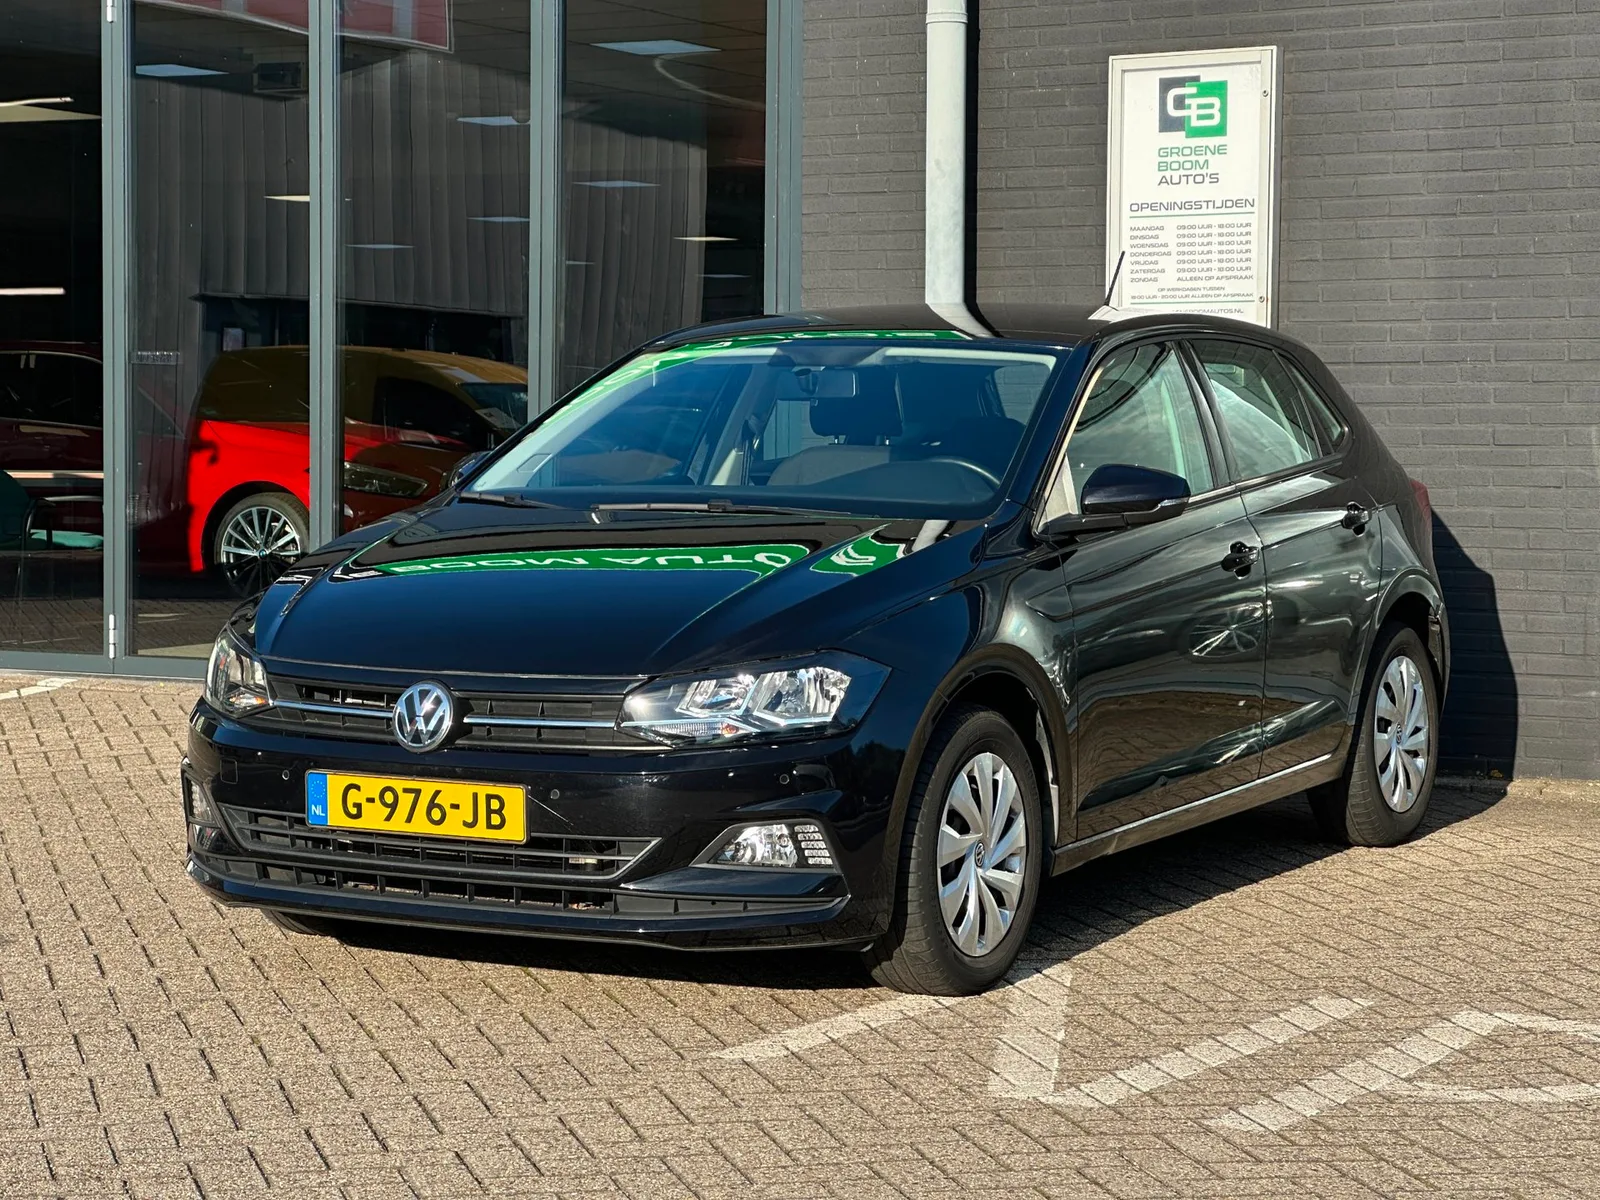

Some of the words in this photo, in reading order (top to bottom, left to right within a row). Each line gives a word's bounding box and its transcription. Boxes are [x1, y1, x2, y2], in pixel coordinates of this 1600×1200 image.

[1158, 144, 1228, 158] GROENE
[1157, 159, 1209, 172] BOOM
[1157, 172, 1220, 186] AUTO'S
[1129, 198, 1255, 212] OPENINGSTIJDEN
[311, 804, 326, 817] NL
[341, 783, 507, 831] G-976-JB
